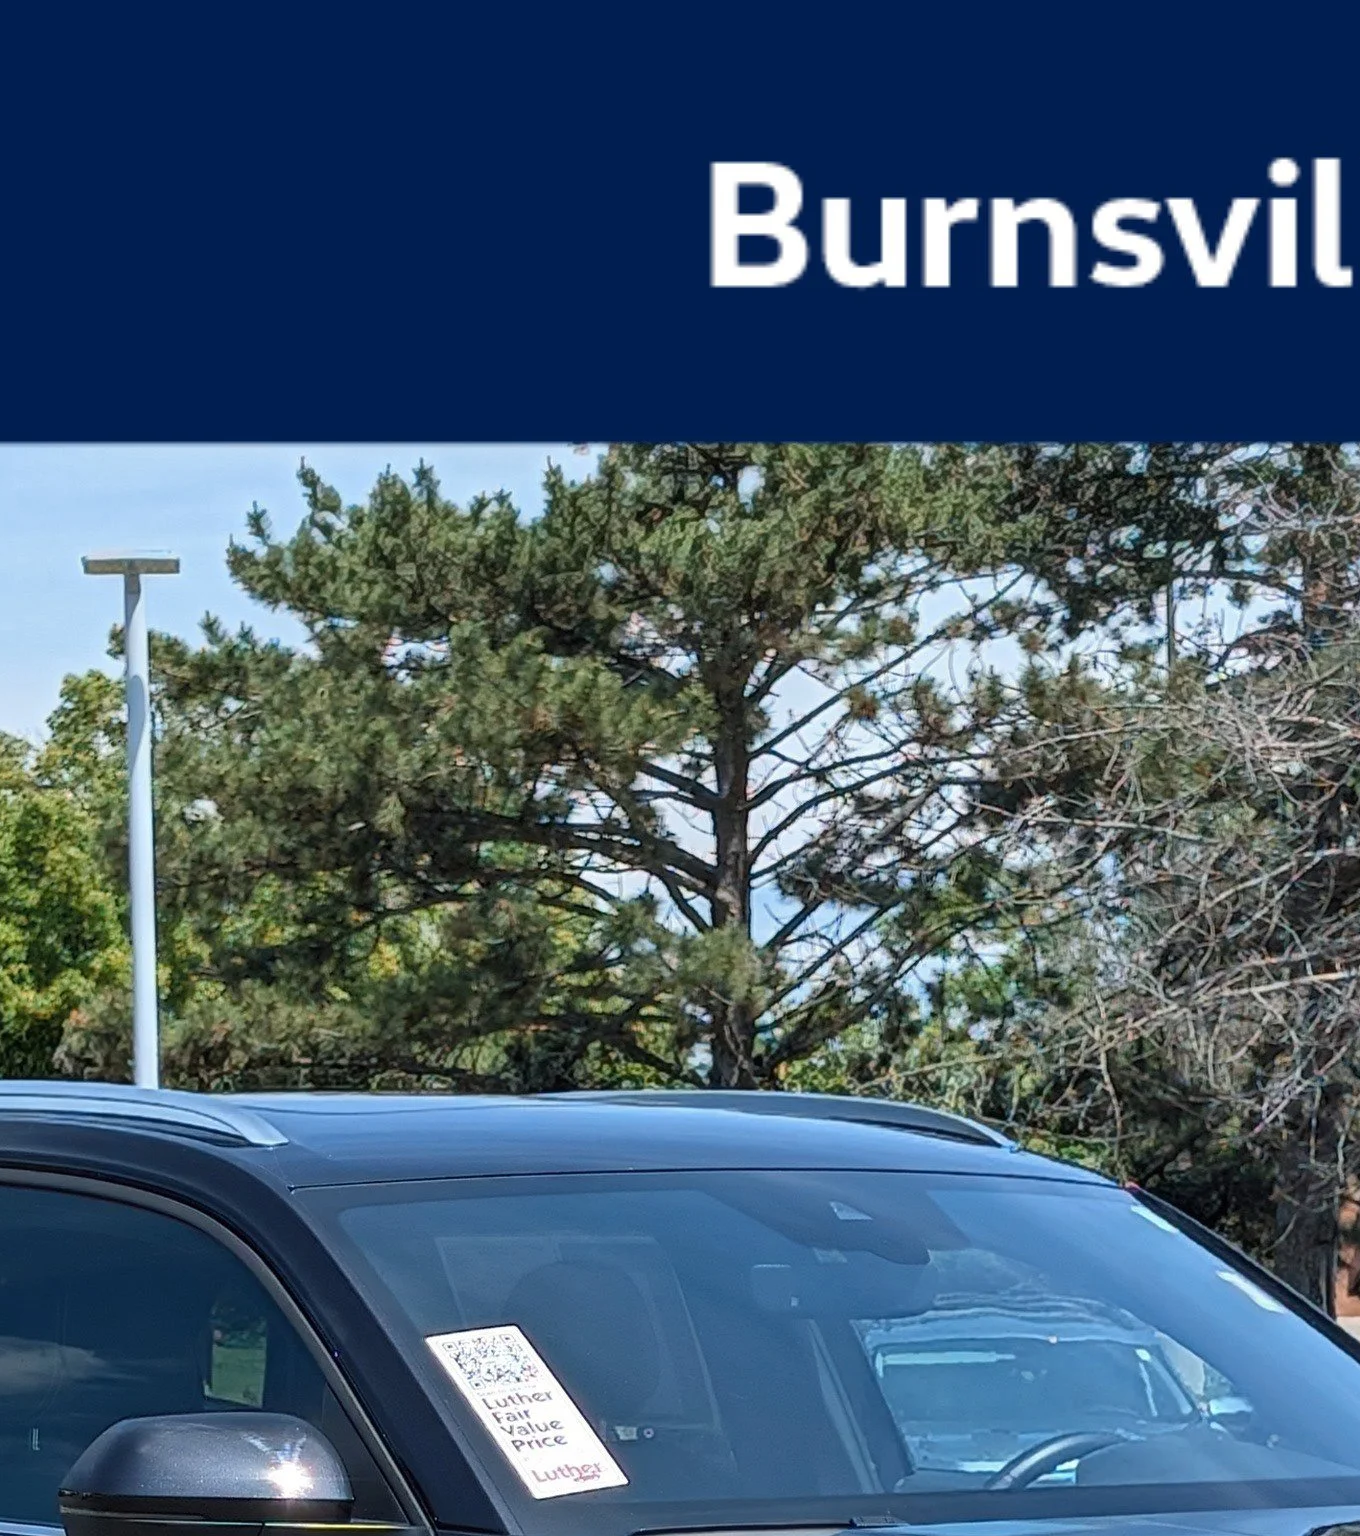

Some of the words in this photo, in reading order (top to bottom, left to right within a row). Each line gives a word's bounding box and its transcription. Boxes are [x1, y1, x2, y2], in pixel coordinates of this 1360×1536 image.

[482, 1391, 554, 1410] Luther
[491, 1408, 532, 1424] Fair
[500, 1419, 565, 1437] Value
[511, 1434, 568, 1452] Price
[531, 1462, 602, 1483] Luther
